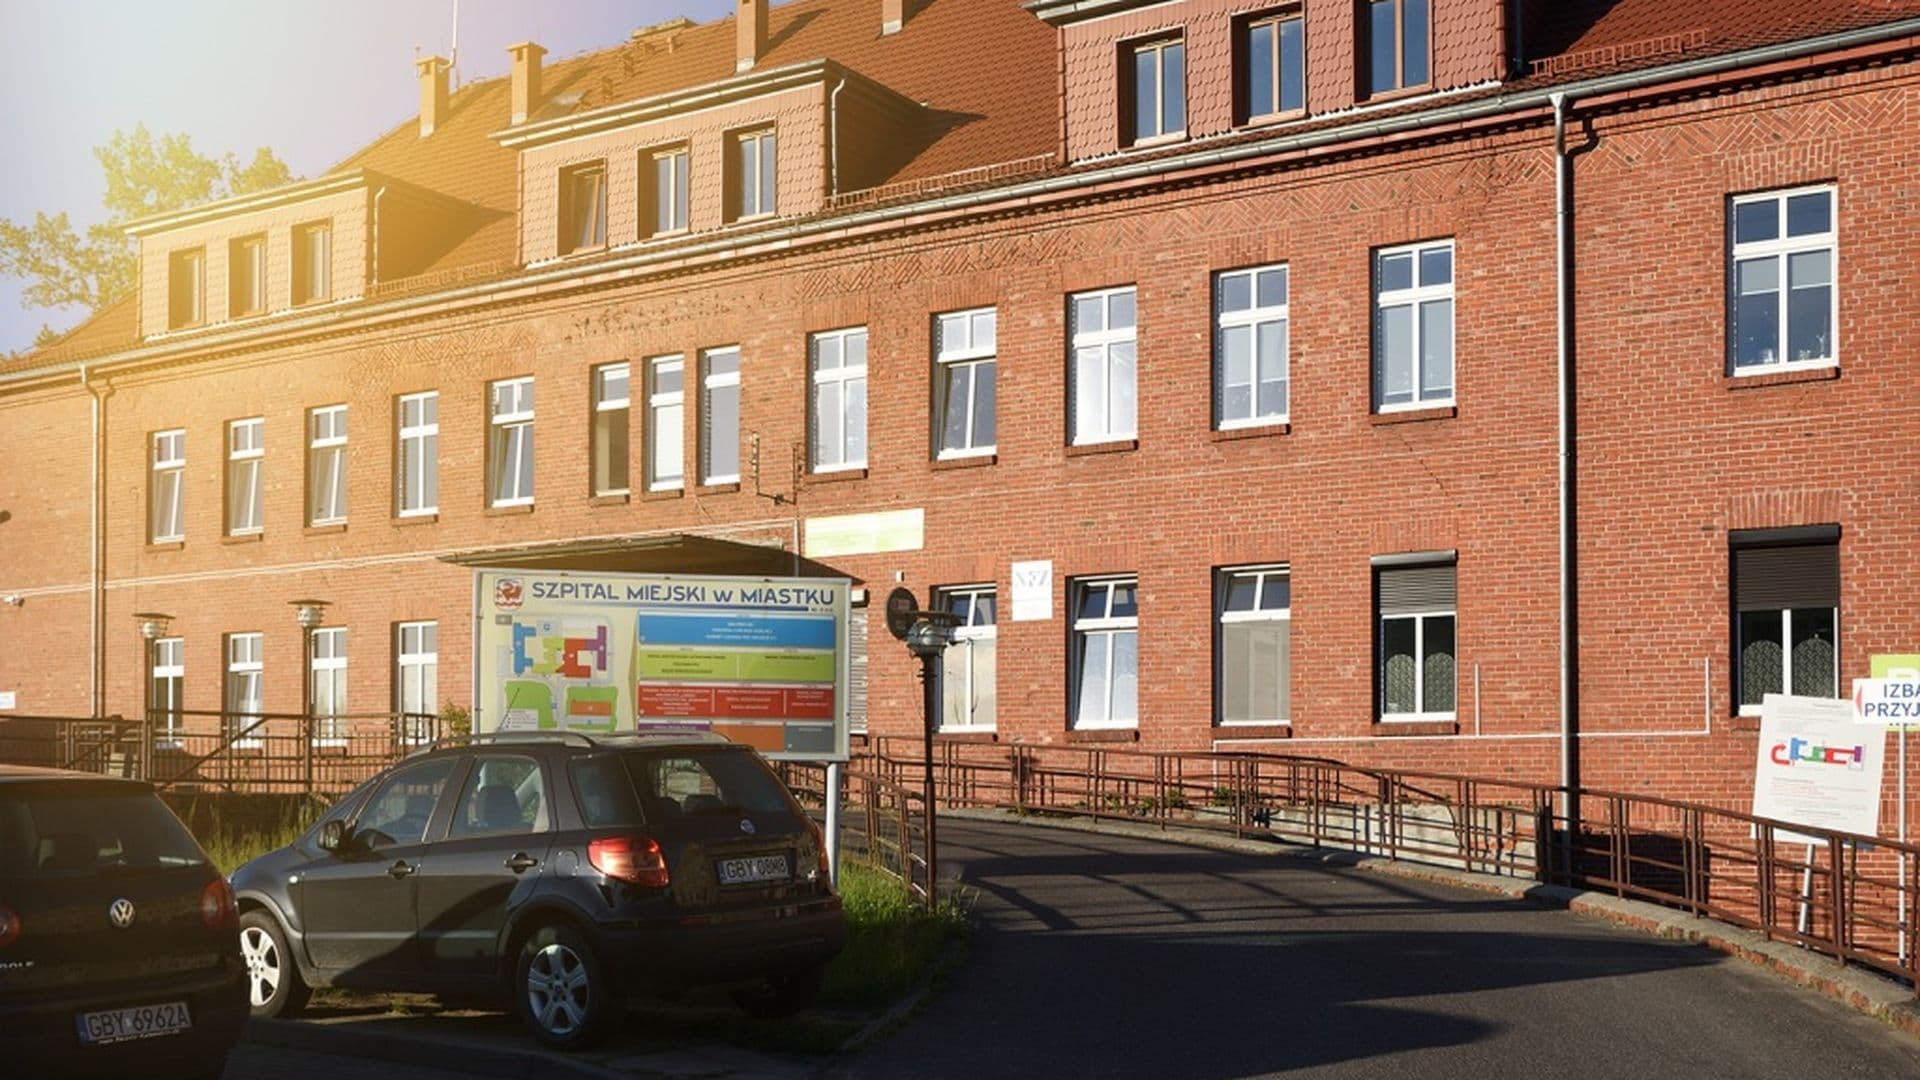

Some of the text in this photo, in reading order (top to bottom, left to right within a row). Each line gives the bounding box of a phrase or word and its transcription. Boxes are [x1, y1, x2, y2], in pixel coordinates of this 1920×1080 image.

[532, 582, 620, 600] SZPITAL
[627, 585, 706, 602] MIEJSKI
[740, 588, 835, 605] MIASTKU
[727, 860, 752, 878] GBY
[87, 1012, 125, 1037] GBY
[133, 1004, 189, 1032] 6962A
